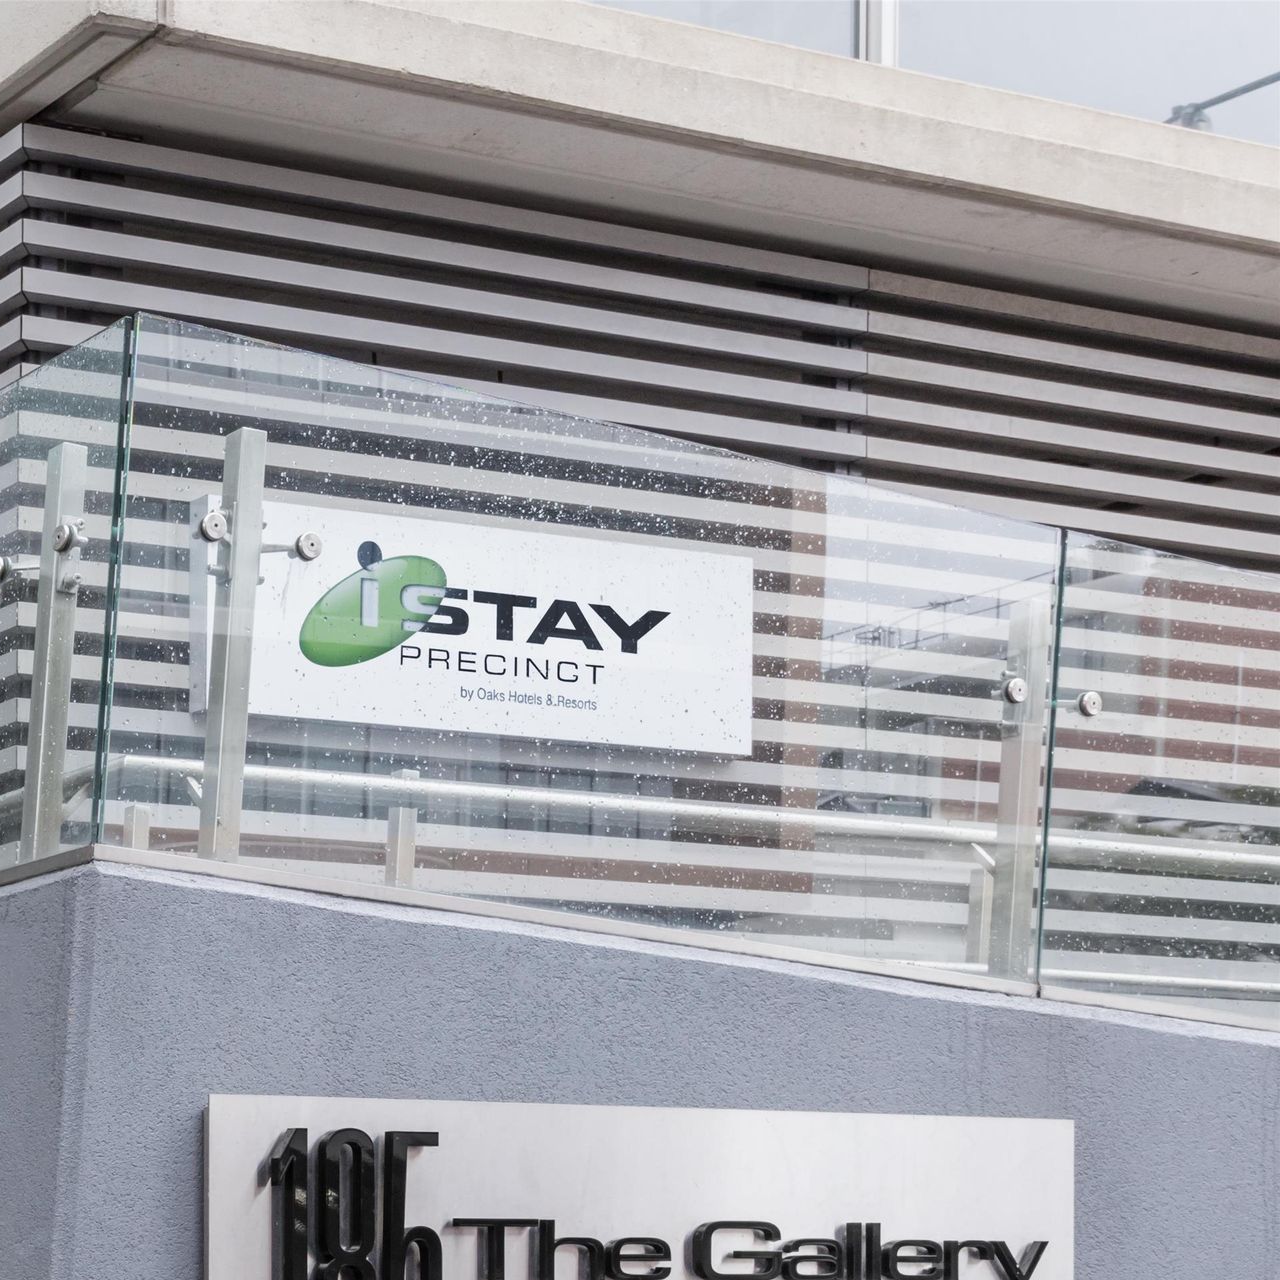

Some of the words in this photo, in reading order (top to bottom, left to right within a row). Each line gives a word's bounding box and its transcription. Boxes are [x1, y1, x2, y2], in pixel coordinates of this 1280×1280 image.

[400, 645, 605, 684] PRECINCT
[460, 686, 474, 701] by
[477, 687, 505, 702] Oaks
[509, 690, 543, 706] Hotels
[546, 694, 553, 706] &
[557, 695, 597, 711] Resorts
